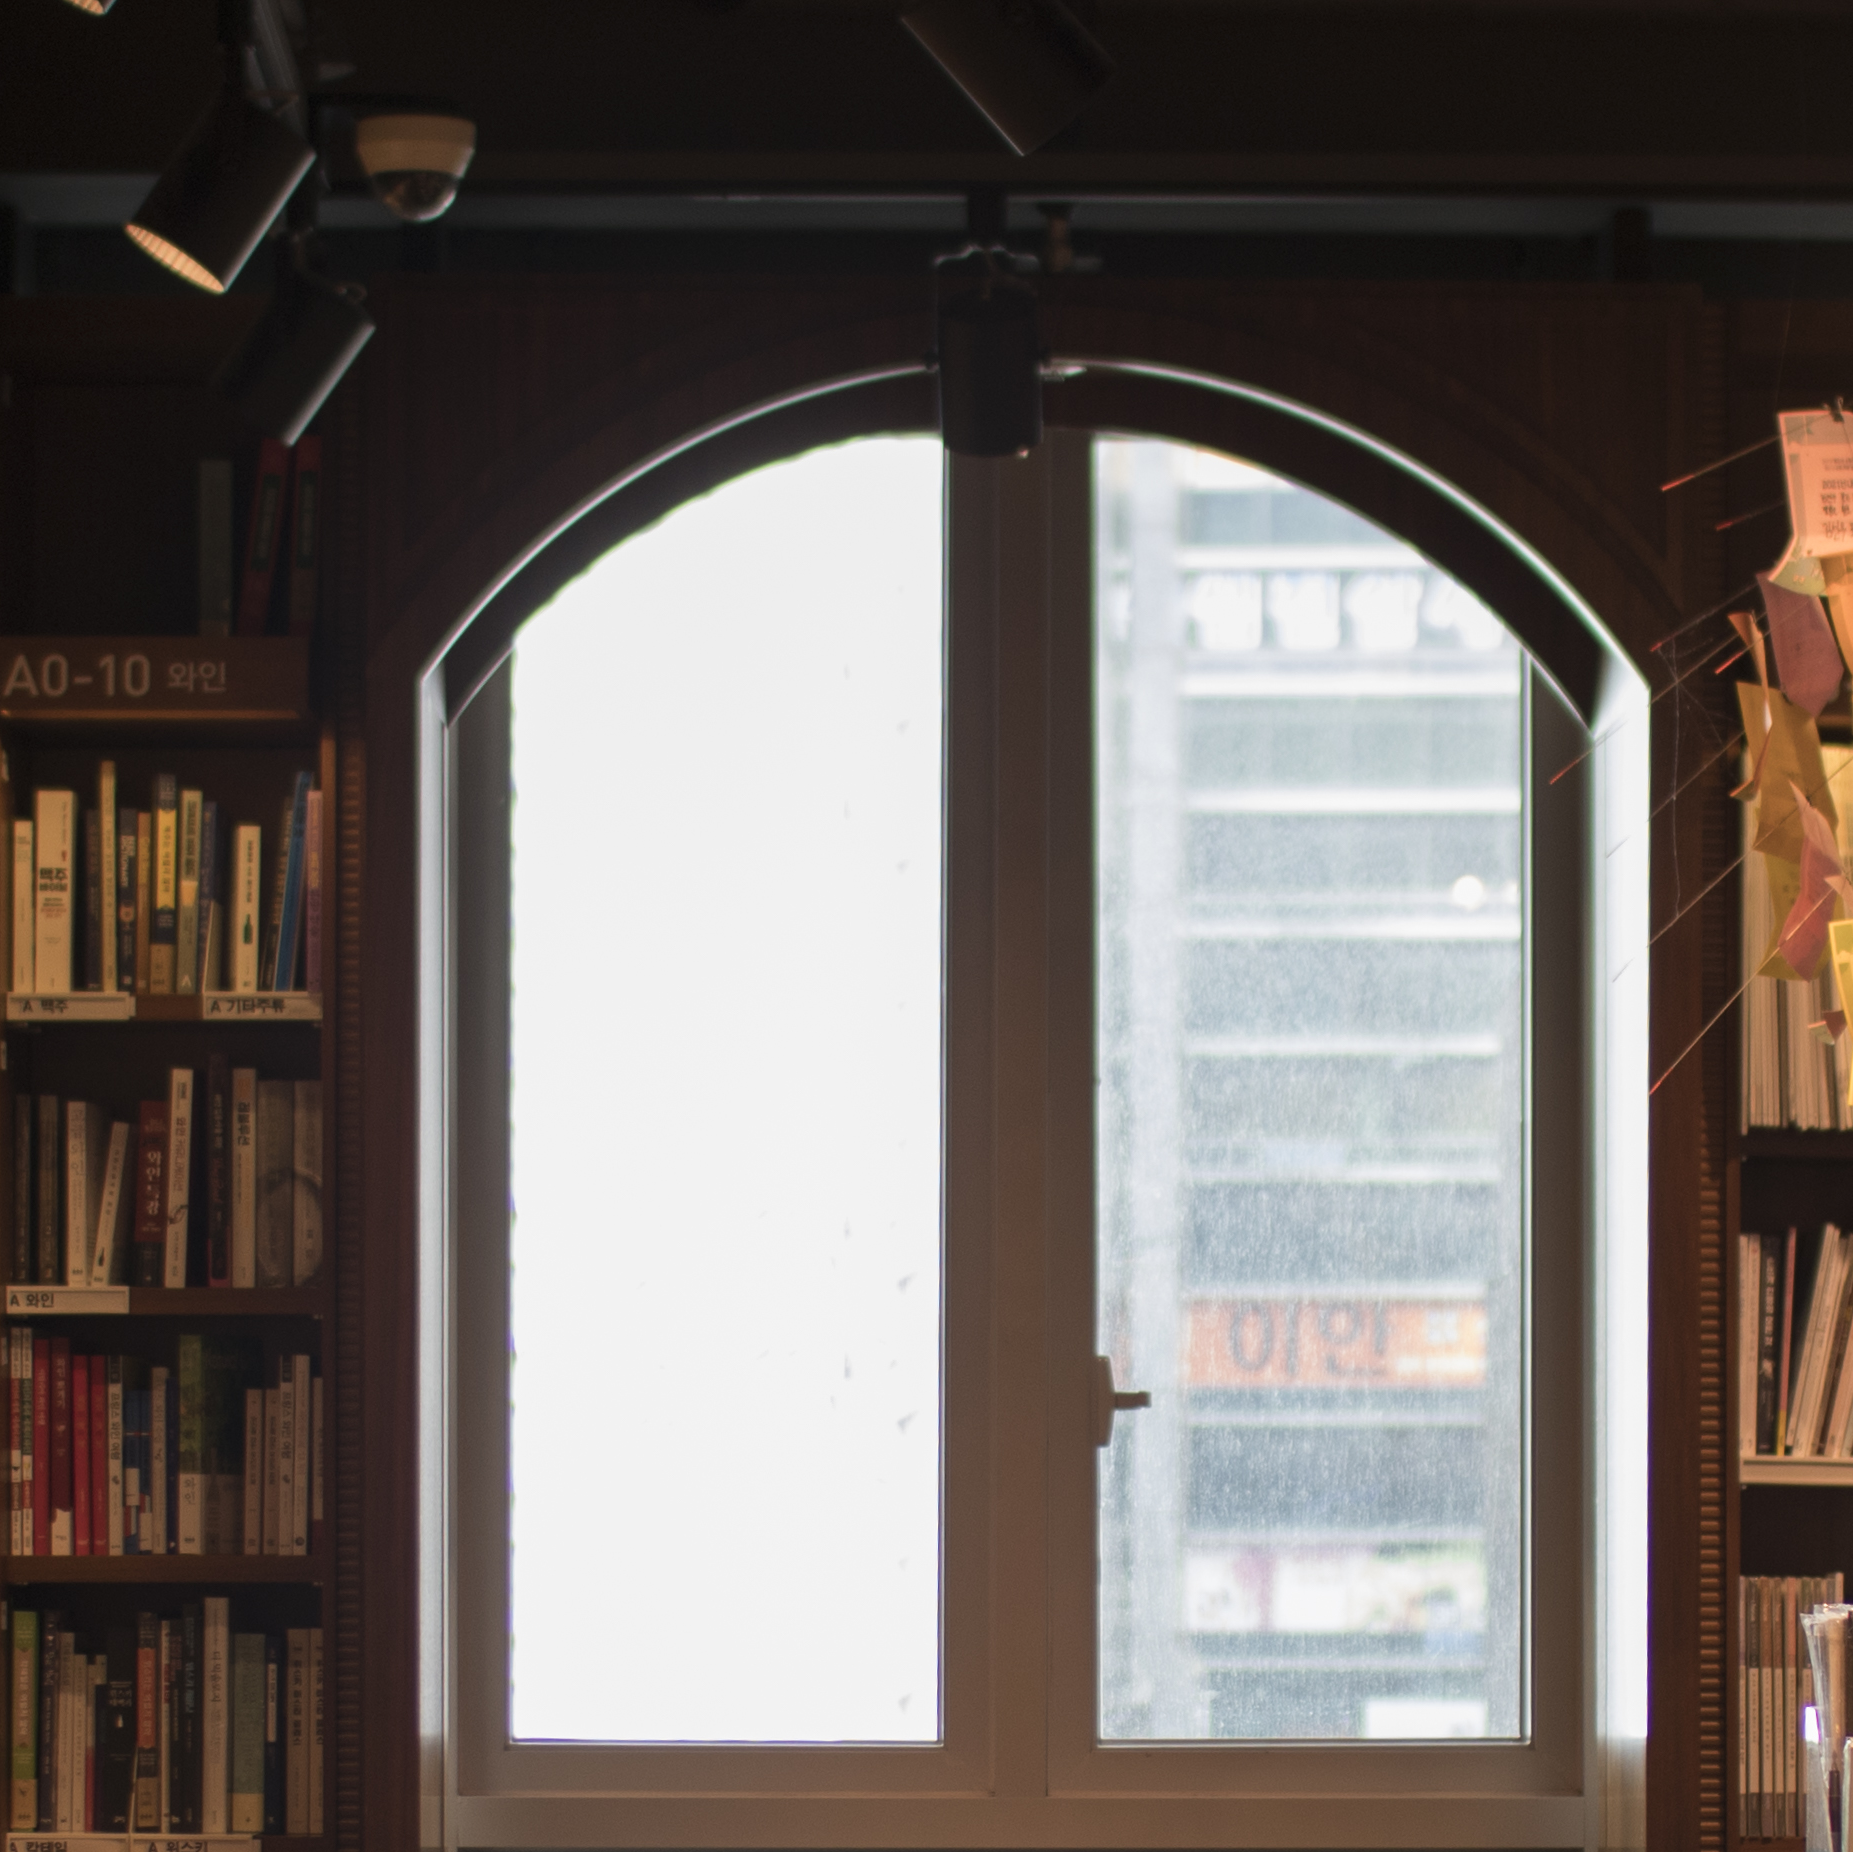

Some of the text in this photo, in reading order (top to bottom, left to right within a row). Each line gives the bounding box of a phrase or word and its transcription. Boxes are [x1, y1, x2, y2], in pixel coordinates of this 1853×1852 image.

[2, 653, 226, 697] A0-10 와인
[39, 867, 68, 881] 맥주
[21, 999, 68, 1014] A 맥주
[210, 998, 286, 1014] A 기타주류
[237, 1102, 251, 1146] 레볼루션
[9, 1293, 55, 1309] A 와인
[110, 1392, 121, 1460] 프랑스 와인 여행
[282, 1391, 293, 1460] 프랑스 와인 여행
